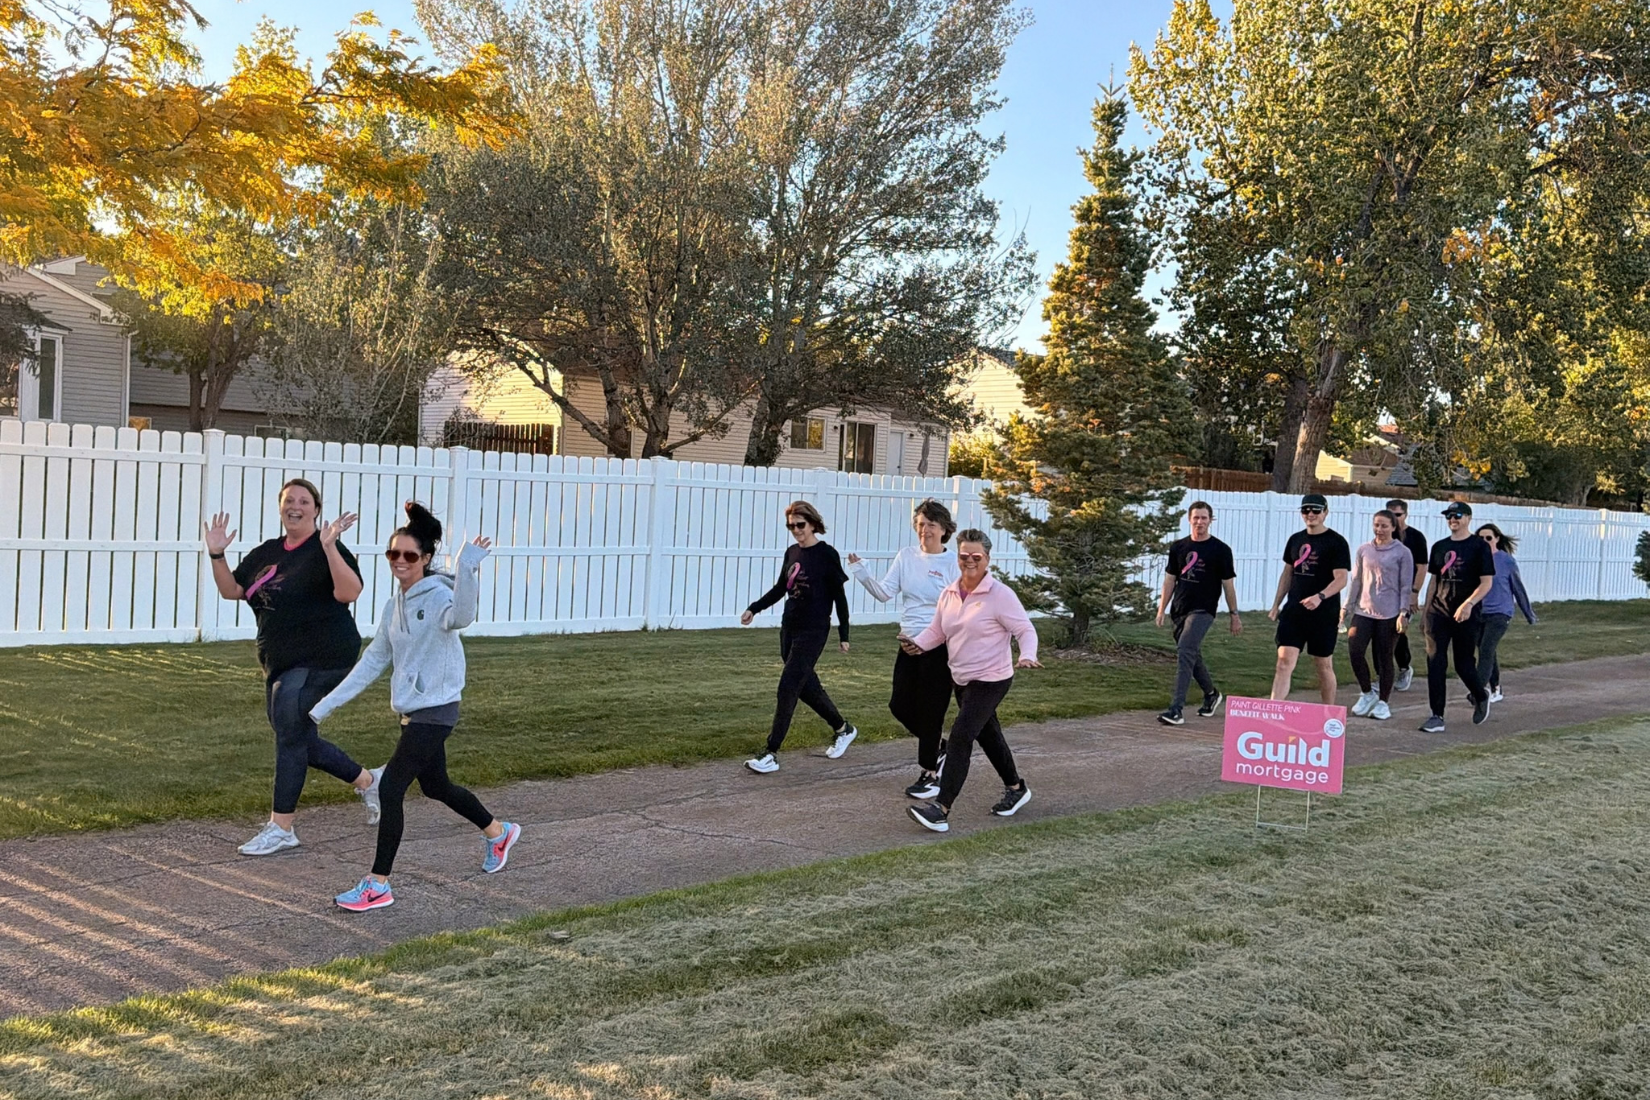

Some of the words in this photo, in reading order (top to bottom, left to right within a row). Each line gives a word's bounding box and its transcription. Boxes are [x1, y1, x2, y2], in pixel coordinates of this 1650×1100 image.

[1230, 700, 1251, 708] PAINT
[1252, 702, 1283, 712] GILLETTE
[1230, 709, 1260, 718] BENEFIT
[1262, 712, 1285, 721] WALK
[1237, 731, 1331, 768] Guild
[1236, 763, 1329, 785] mortgage
